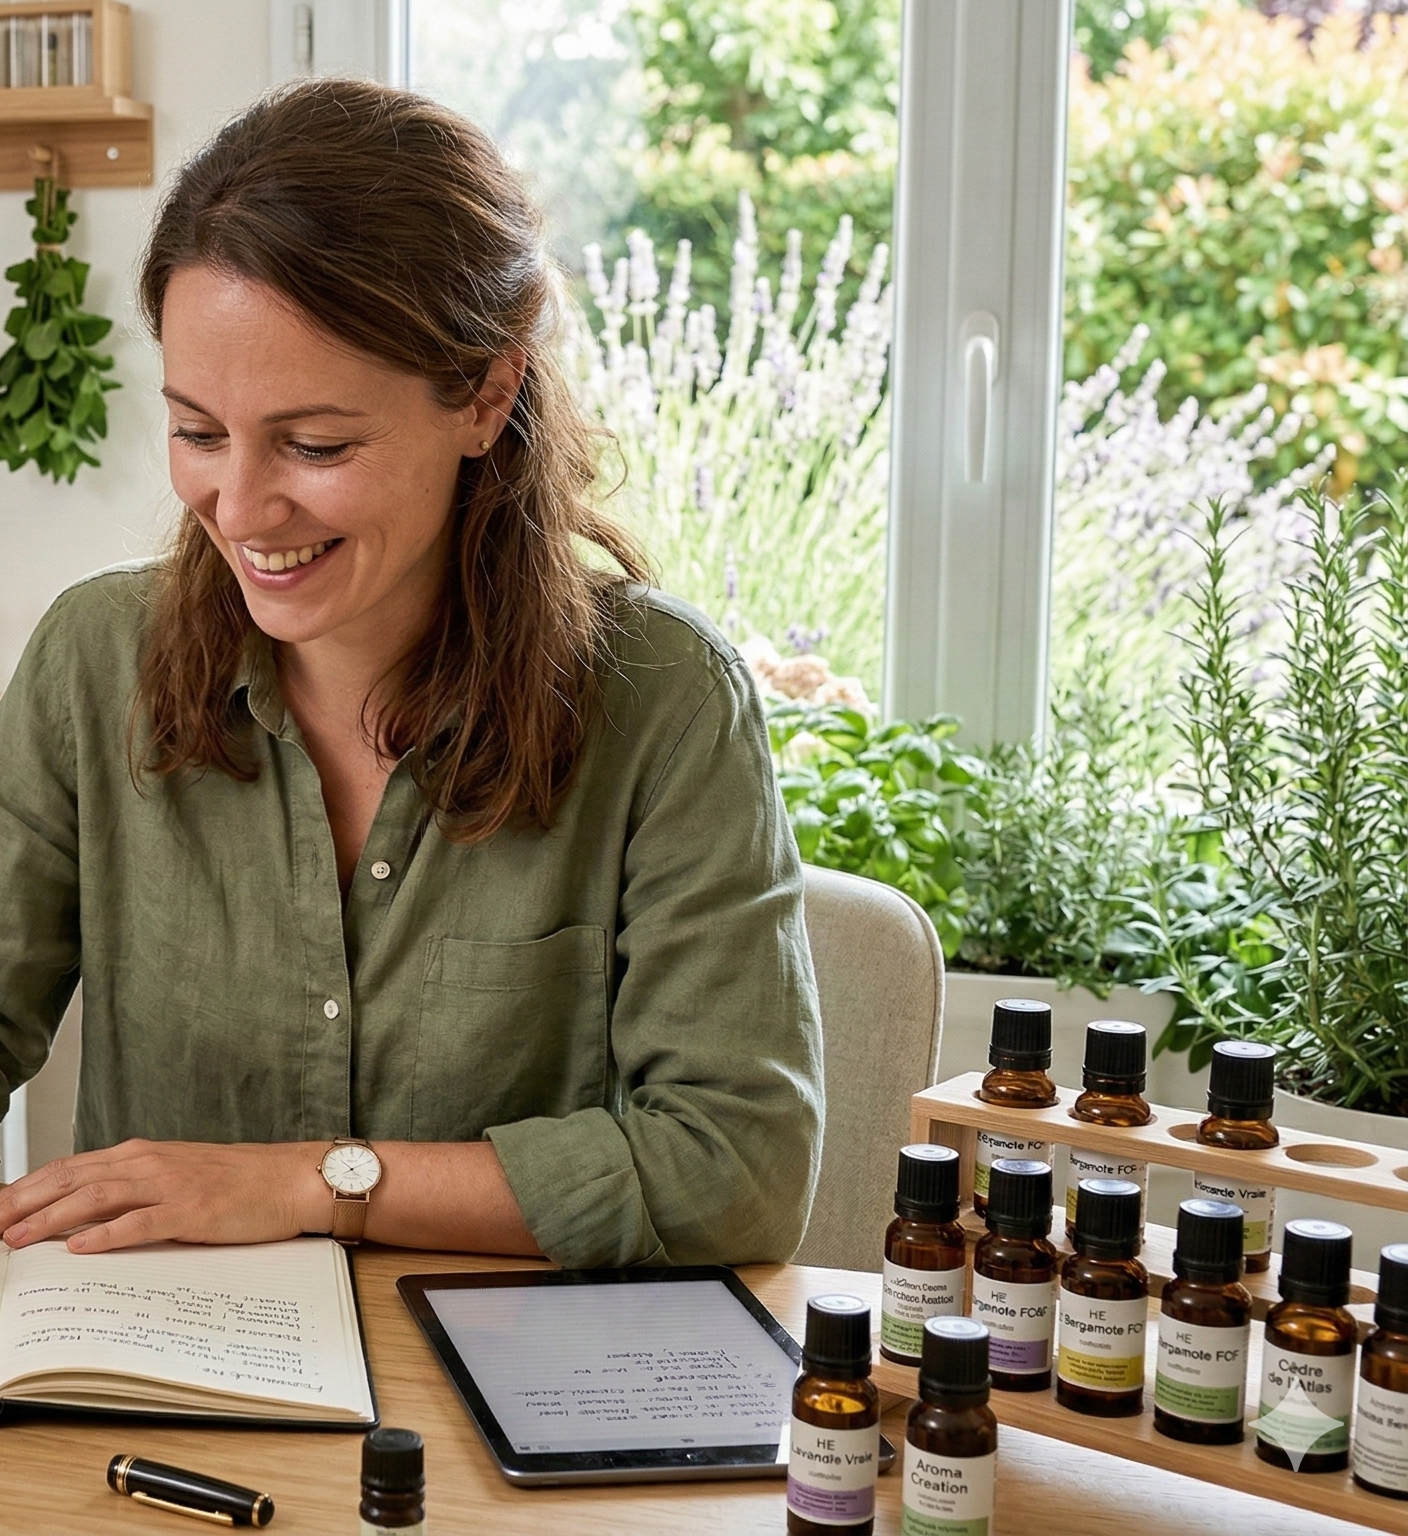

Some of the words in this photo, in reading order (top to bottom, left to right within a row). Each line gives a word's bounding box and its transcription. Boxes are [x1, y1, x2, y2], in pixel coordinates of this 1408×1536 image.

[1064, 1314, 1124, 1336] Bergamote
[1089, 1309, 1107, 1321] HE
[1176, 1331, 1193, 1344] HE
[1268, 1371, 1283, 1386] de
[1287, 1375, 1333, 1394] l'Atlas
[817, 1437, 836, 1450] HE
[916, 1459, 963, 1479] Aroma
[911, 1472, 969, 1494] Creation
